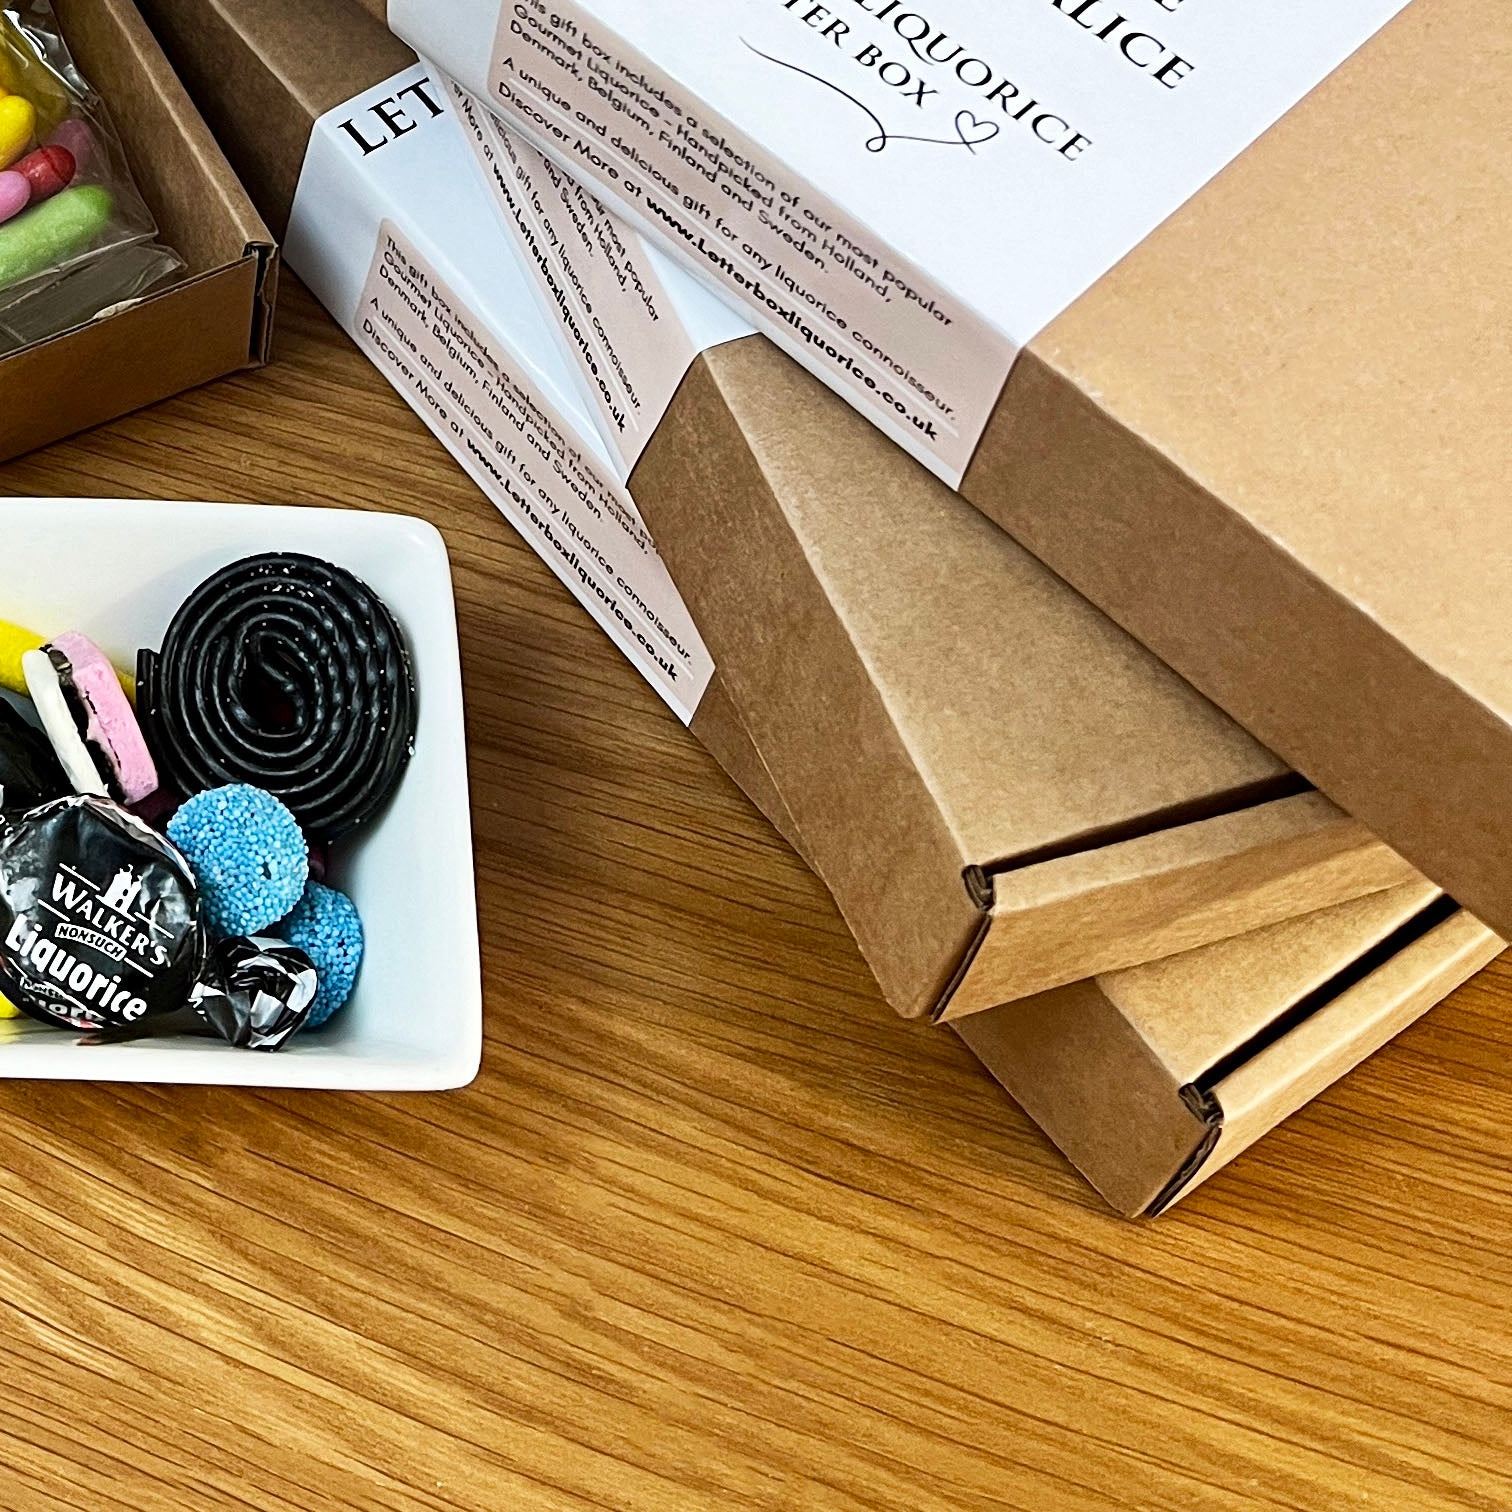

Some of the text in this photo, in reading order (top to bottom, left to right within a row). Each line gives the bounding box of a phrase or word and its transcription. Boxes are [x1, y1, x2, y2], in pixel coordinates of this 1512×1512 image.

[462, 98, 483, 142] More
[484, 144, 494, 162] at
[854, 42, 941, 108] BOX
[498, 81, 571, 143] Discover
[573, 139, 619, 179] More
[623, 179, 643, 197] at
[502, 57, 515, 71] A
[519, 69, 571, 112] unique
[576, 110, 607, 137] and
[611, 136, 679, 196] delicious
[682, 195, 711, 220] gift
[715, 218, 738, 242] for
[742, 243, 773, 271] any
[774, 264, 848, 330] liquorice
[510, 19, 829, 274] Denmark, Belgium, Finland and Sweden.
[514, 4, 583, 60] Gourmet
[587, 57, 660, 118] Liquorice
[677, 124, 774, 208] Handpicked
[778, 206, 817, 242] from
[822, 239, 892, 303] Holland,
[550, 14, 578, 37] gift
[583, 33, 611, 64] box
[616, 60, 683, 116] includes
[686, 117, 698, 128] a
[702, 129, 775, 190] selection
[780, 191, 800, 207] of
[803, 209, 832, 232] our
[836, 233, 878, 268] most
[883, 270, 953, 326] popular
[516, 166, 532, 191] gift
[531, 191, 545, 215] for
[543, 218, 559, 246] any
[558, 244, 593, 314] liquorice
[575, 186, 594, 226] from
[387, 234, 407, 266] This
[431, 286, 452, 314] box
[604, 219, 626, 257] most
[624, 260, 659, 321] popular
[362, 318, 415, 381] Discover
[415, 379, 448, 419] More
[450, 421, 464, 438] at
[384, 251, 432, 309] Gourmet
[434, 306, 485, 368] Liquorice
[496, 376, 565, 460] Handpicked
[568, 459, 596, 494] from
[482, 380, 526, 432] Finland
[526, 433, 551, 461] and
[370, 297, 379, 311] A
[381, 309, 417, 353] unique
[420, 354, 443, 381] and
[444, 381, 493, 440] delicious
[495, 440, 516, 465] gift
[519, 463, 537, 486] for
[538, 489, 561, 514] any
[561, 511, 614, 575] liquorice
[5, 913, 148, 1021] Liquorice
[52, 873, 168, 965] WALKER'S
[58, 925, 125, 958] NONSUCH
